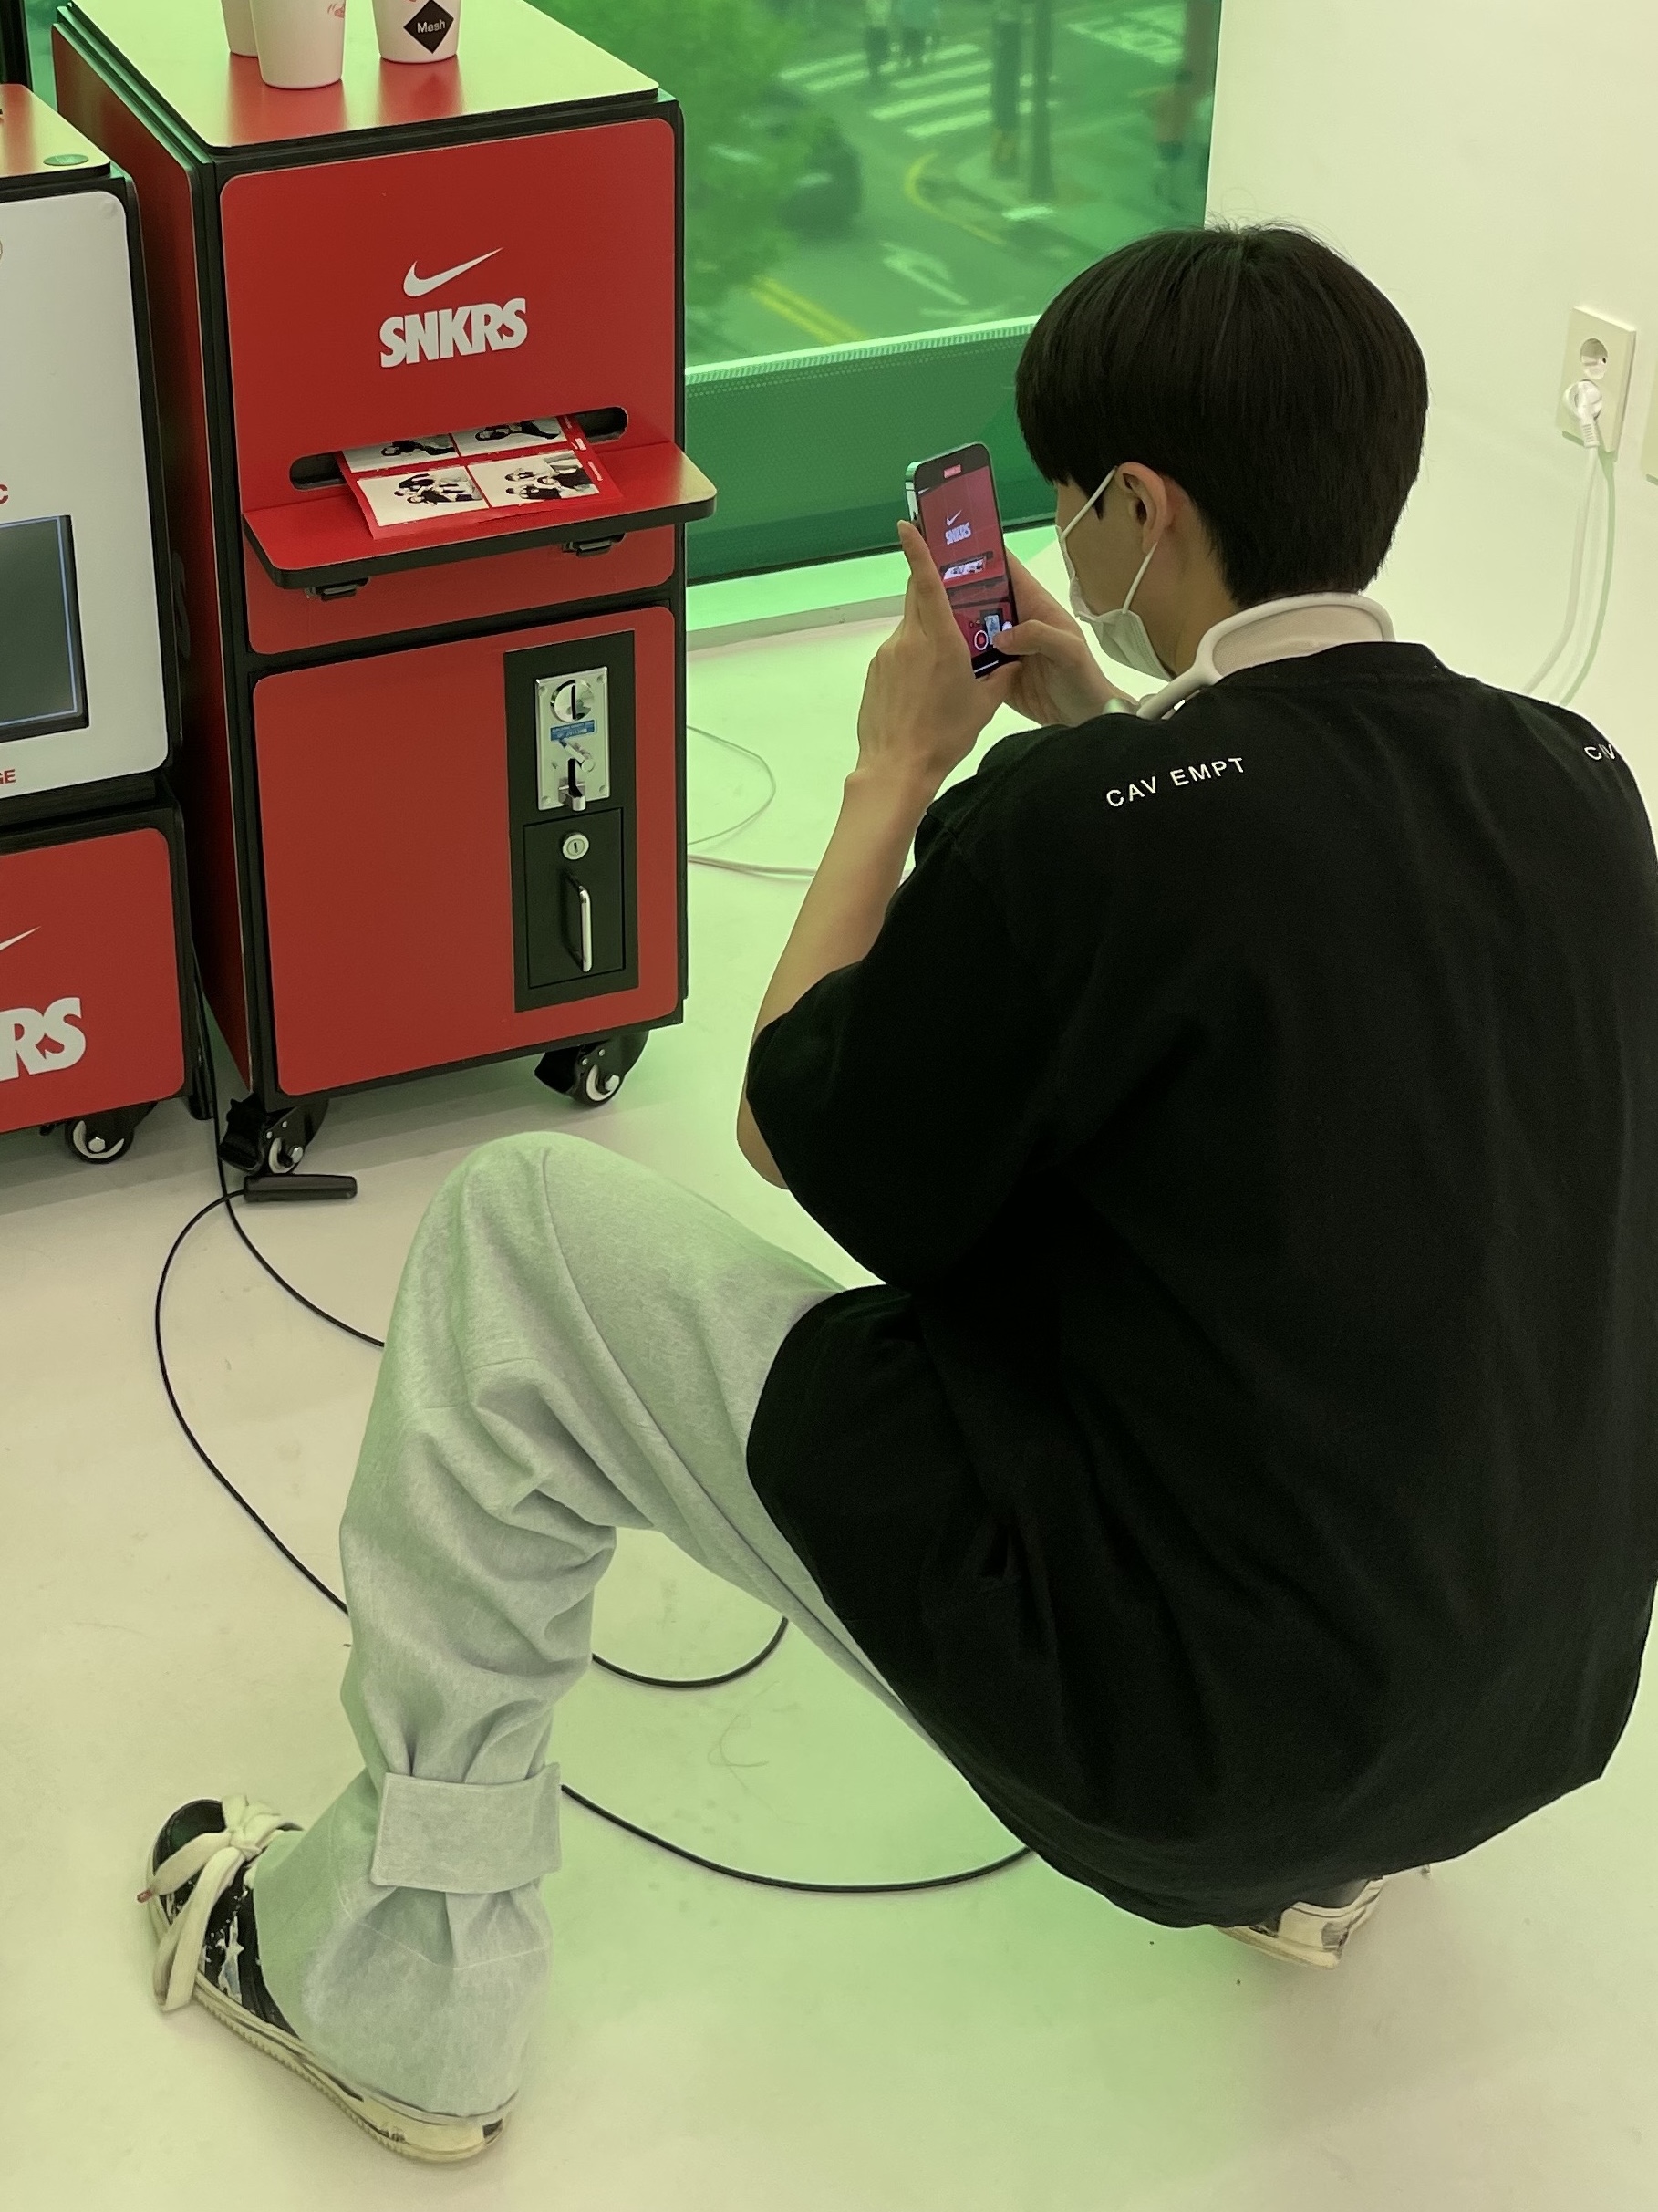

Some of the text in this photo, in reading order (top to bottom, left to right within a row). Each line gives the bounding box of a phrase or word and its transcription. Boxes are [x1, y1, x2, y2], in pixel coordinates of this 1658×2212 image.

[417, 18, 446, 34] Mesh
[379, 297, 528, 368] SNKRS
[1105, 757, 1244, 807] CAV EMPT
